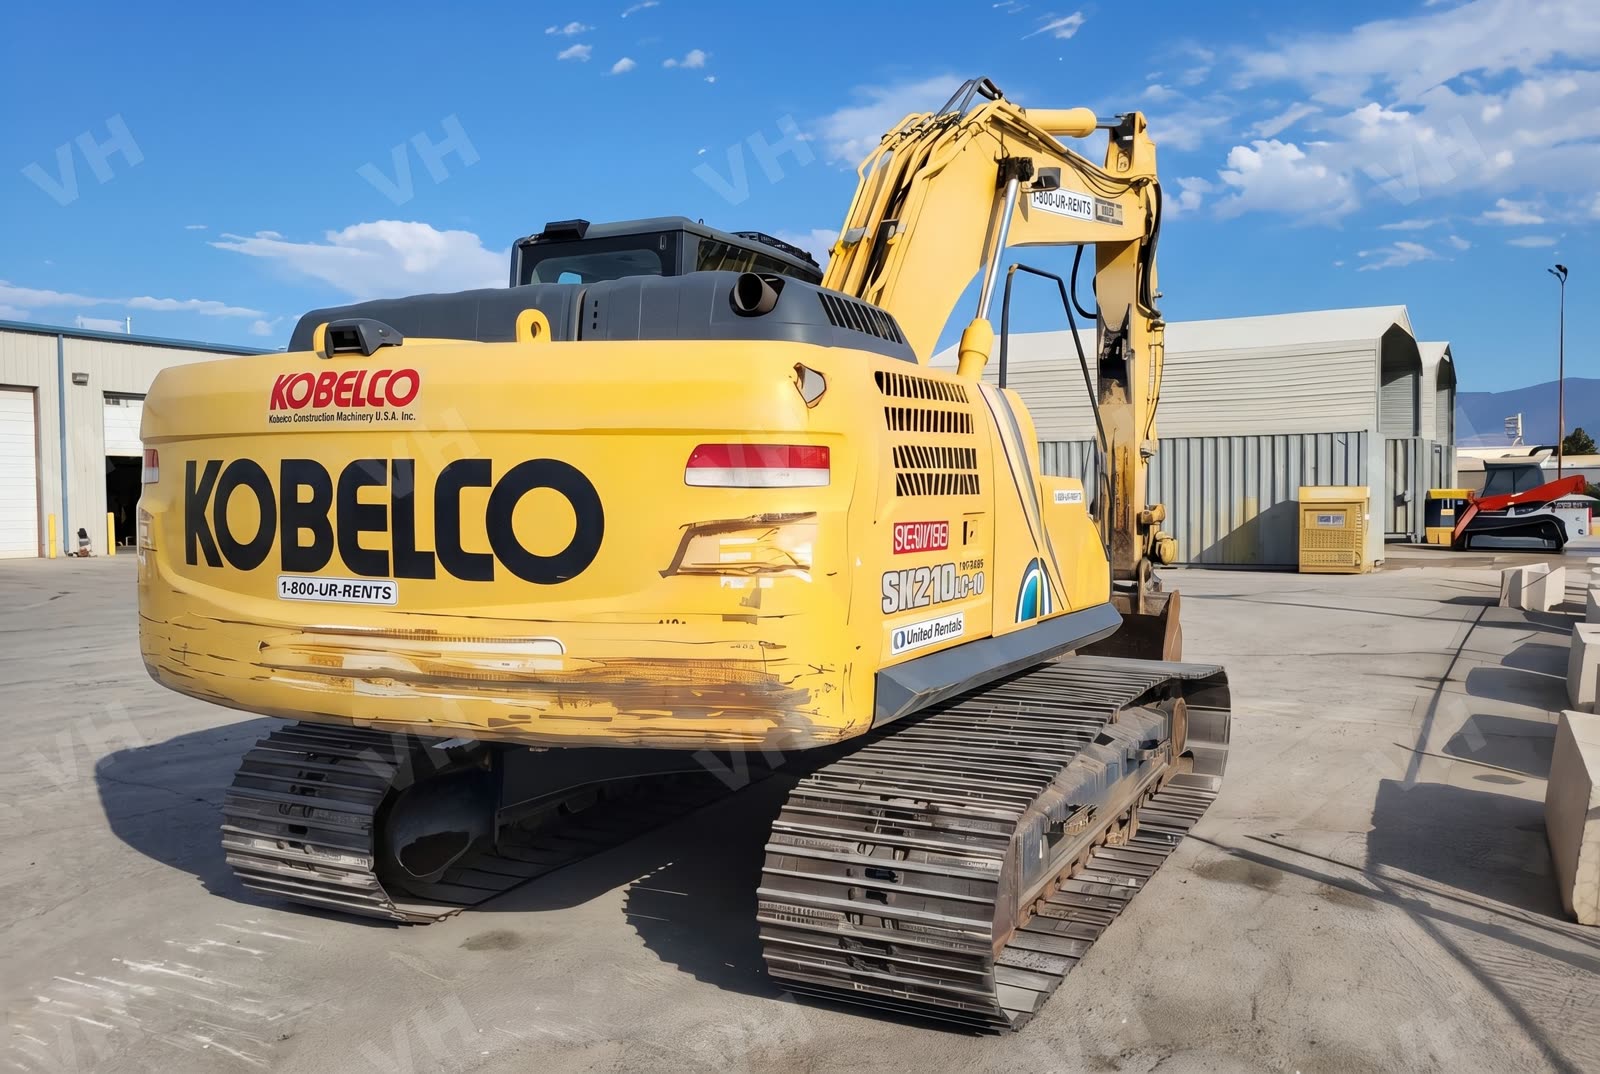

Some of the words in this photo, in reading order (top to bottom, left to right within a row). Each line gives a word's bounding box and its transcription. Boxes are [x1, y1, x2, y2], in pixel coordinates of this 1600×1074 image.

[1033, 190, 1091, 215] 1-800-UR-RENTS
[270, 368, 420, 410] KOBELCO
[293, 411, 335, 423] Construction
[336, 410, 374, 424] Machinery
[375, 411, 399, 422] U.S.A.
[401, 411, 416, 421] Inc.
[185, 458, 605, 585] KOBELCO
[281, 581, 392, 600] 1-800-UR-RENTS
[906, 624, 933, 645] United
[934, 617, 962, 638] Rentals
